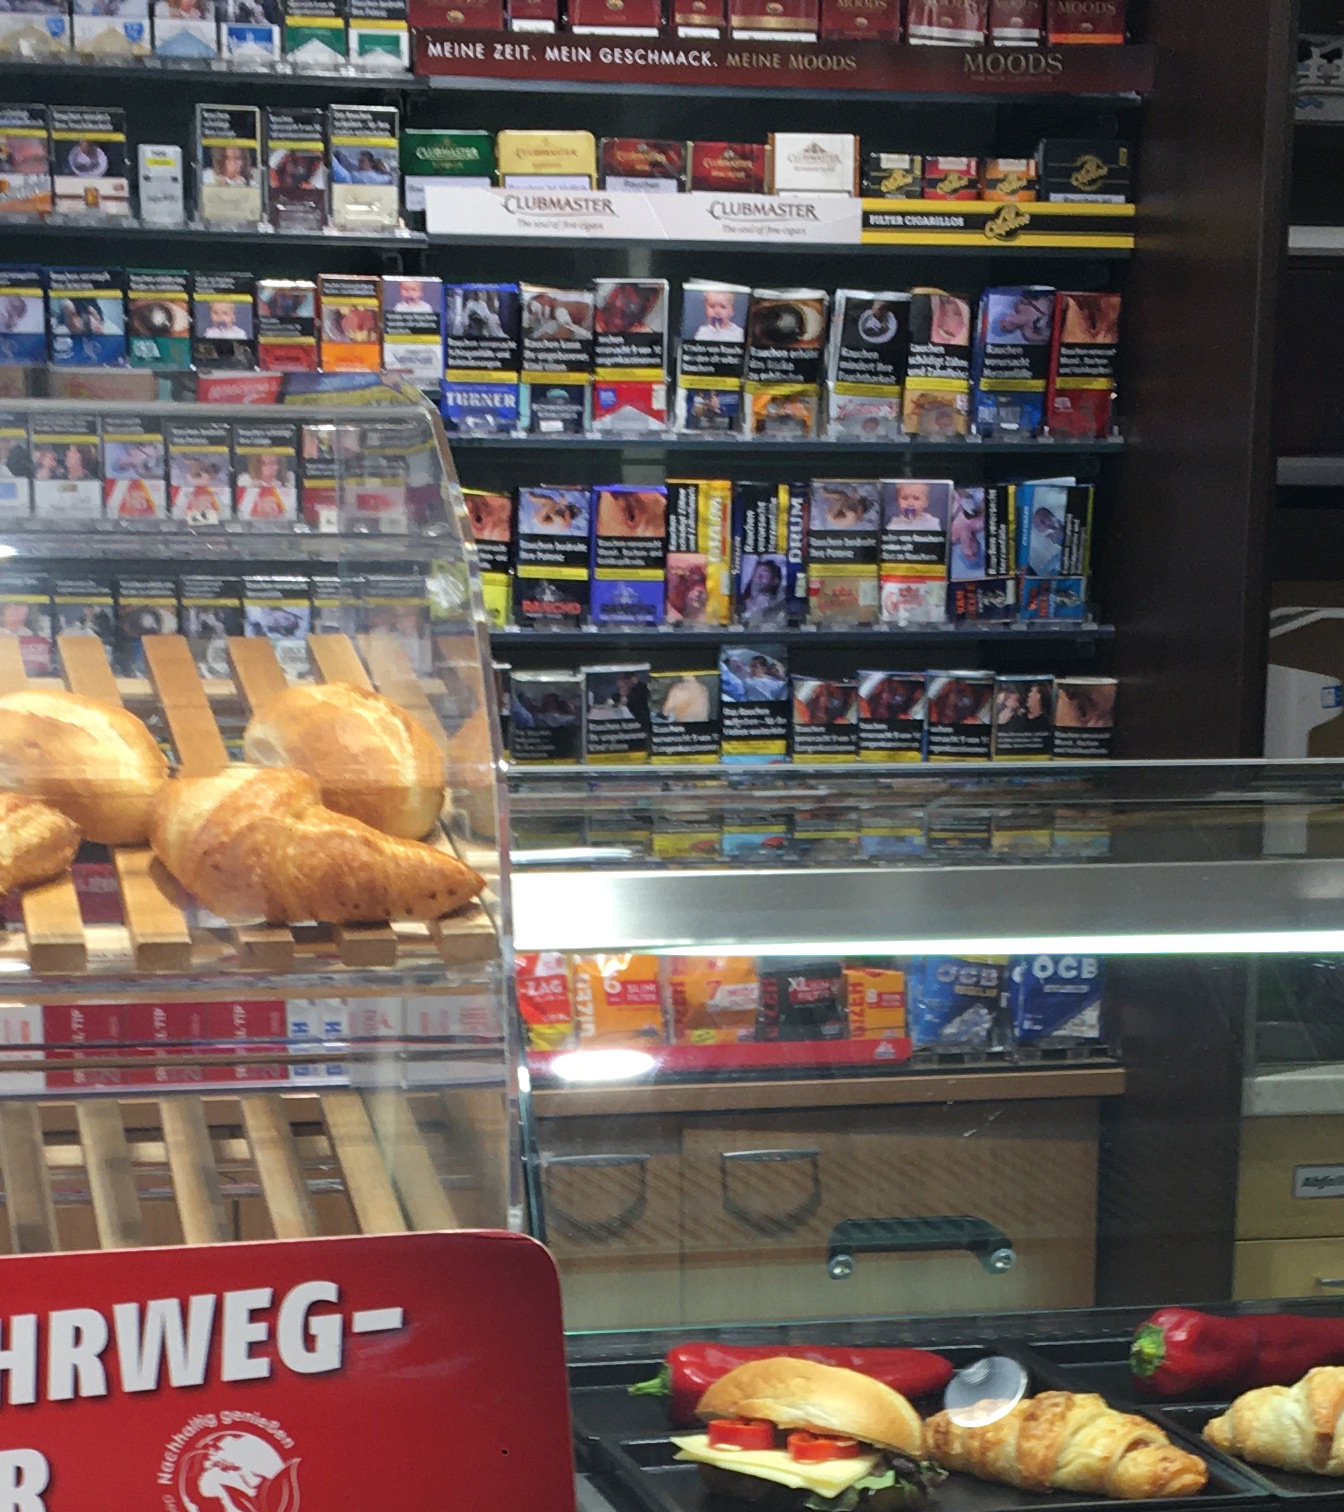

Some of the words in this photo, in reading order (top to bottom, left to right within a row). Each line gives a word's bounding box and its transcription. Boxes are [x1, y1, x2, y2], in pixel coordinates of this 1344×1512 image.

[427, 41, 485, 60] MEINE
[493, 43, 537, 61] ZEIT.
[544, 45, 592, 63] MEIN
[599, 47, 718, 68] GESCHMACK.
[726, 53, 781, 70] MEINE
[789, 54, 857, 72] MOODS
[964, 52, 1063, 75] MOODS
[502, 194, 616, 216] CLUBMASTER
[707, 200, 820, 222] CLUBMASTER
[446, 393, 517, 409] TURNER
[789, 497, 804, 564] DRUM
[936, 963, 999, 986] OCB
[1031, 955, 1099, 980] OCB
[603, 973, 622, 994] 6
[157, 1414, 218, 1485] Nachhaltig
[220, 1410, 295, 1449] genießen
